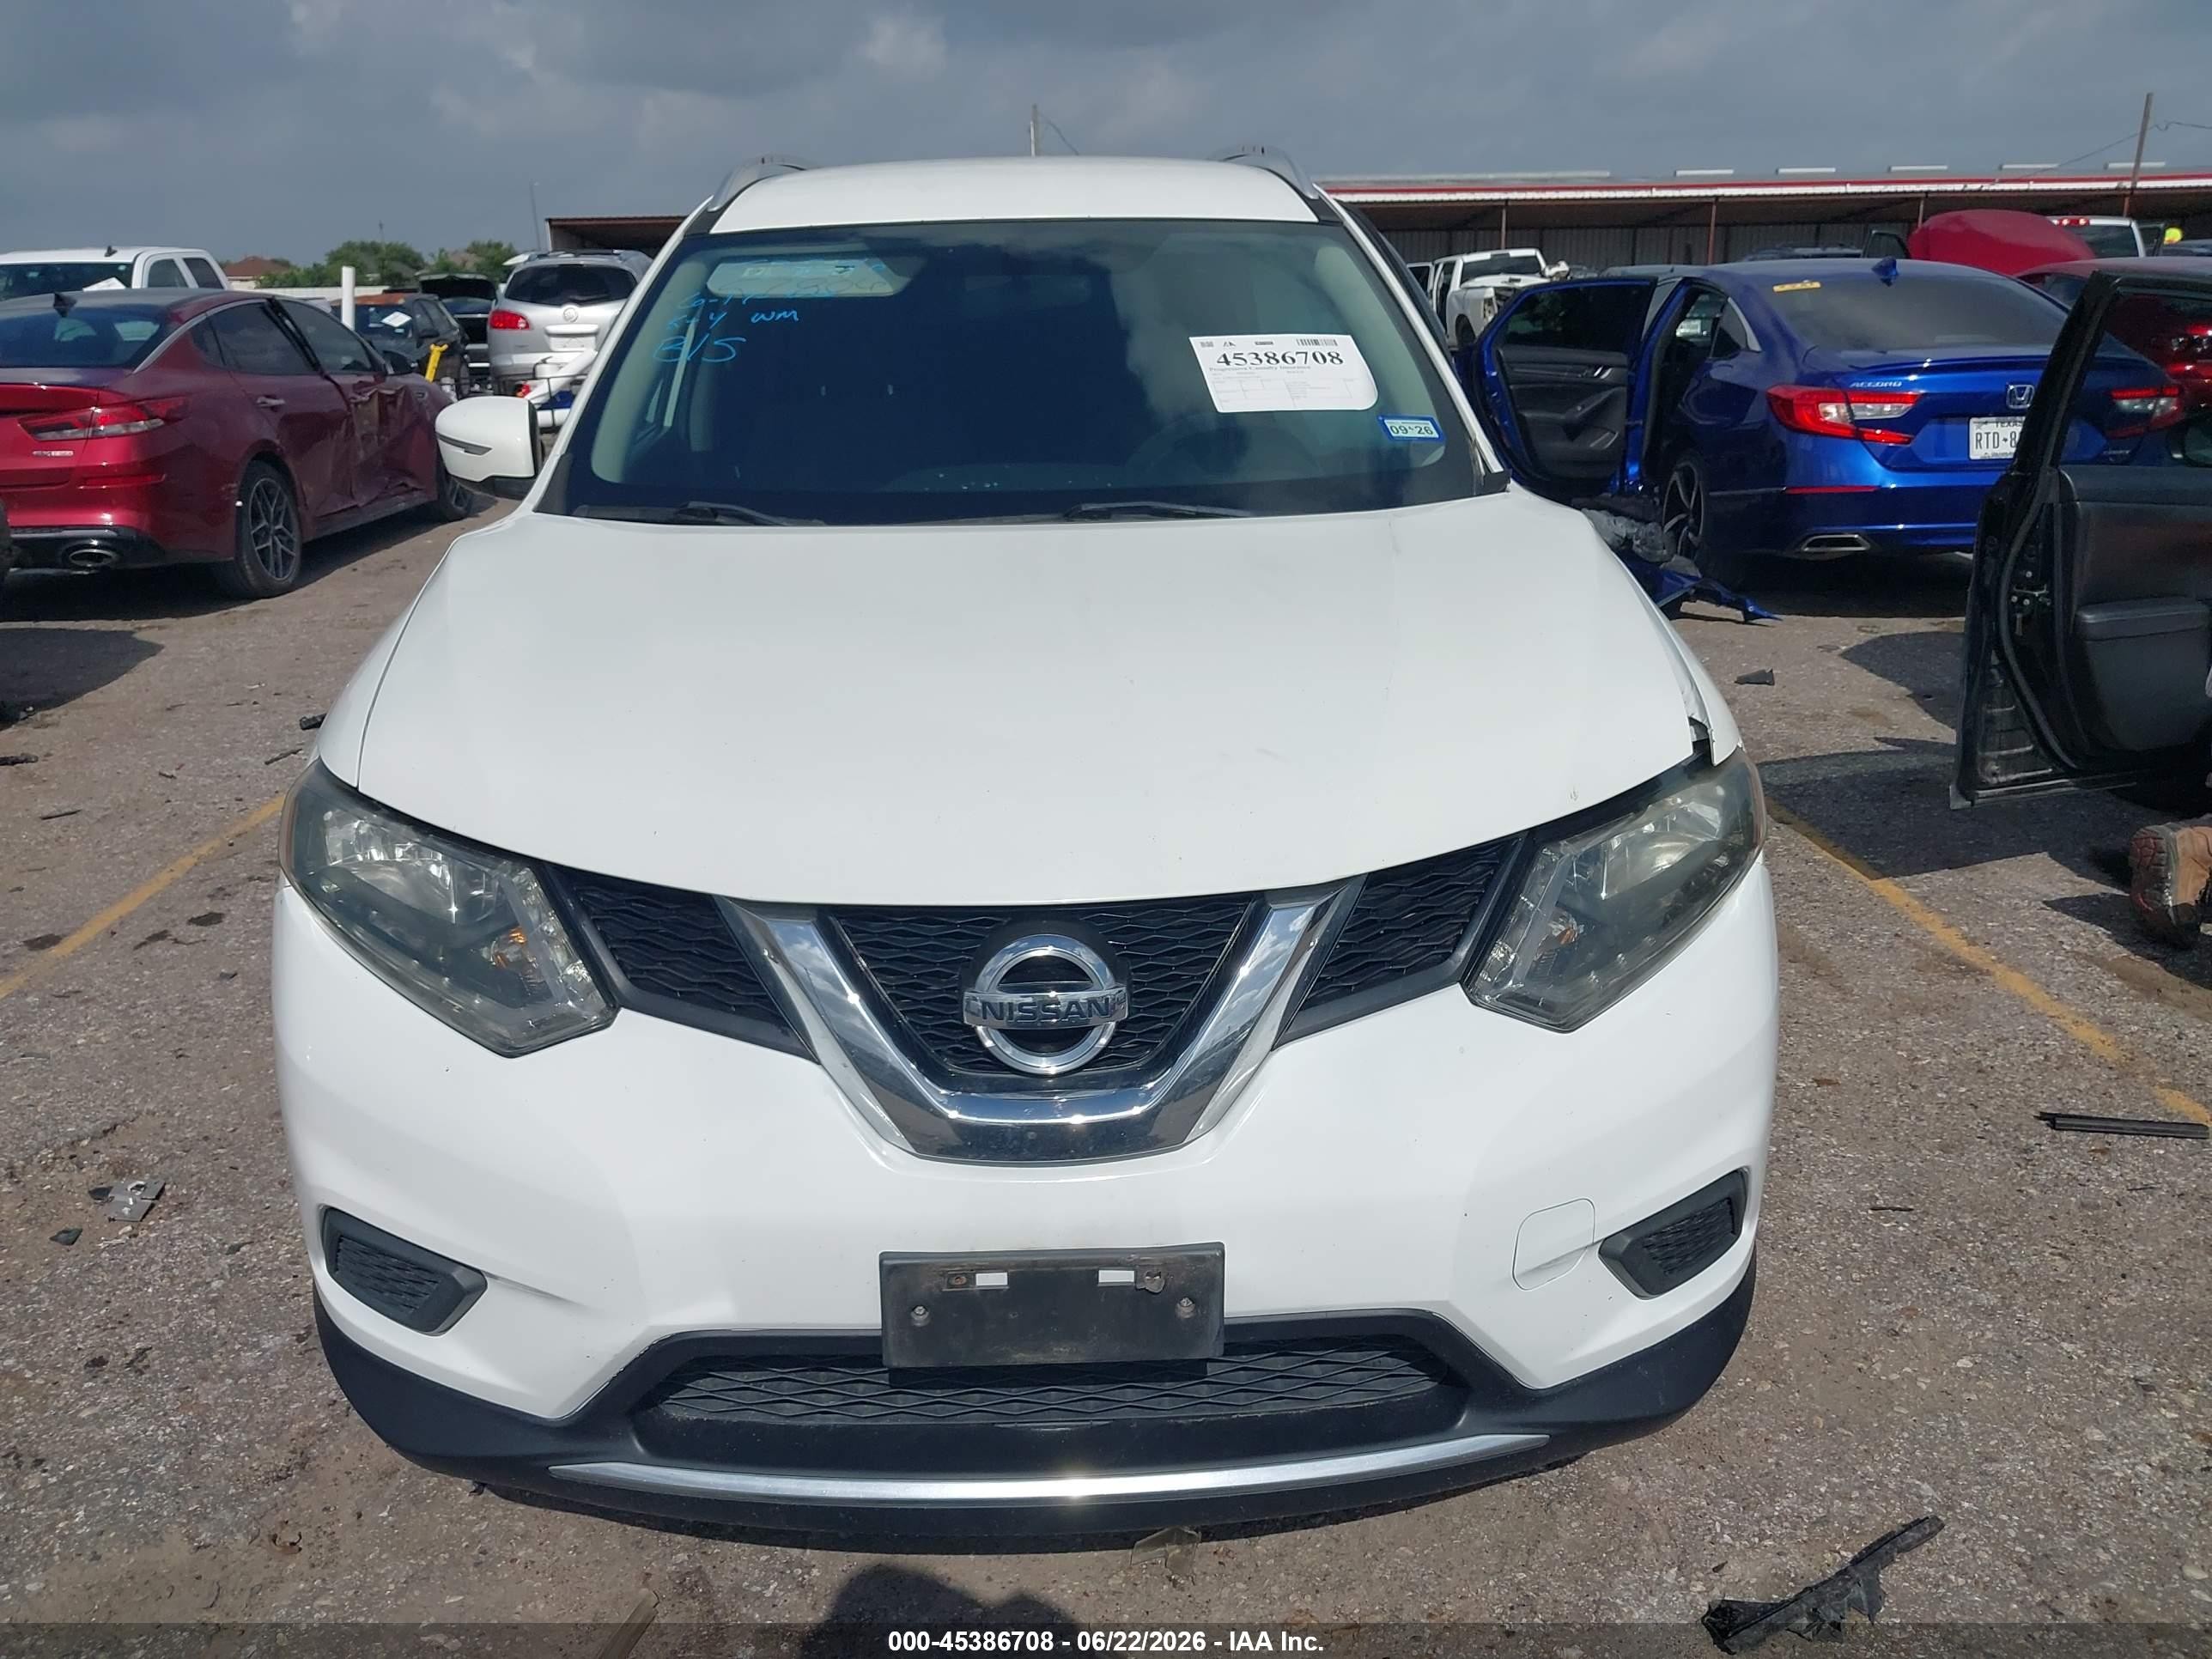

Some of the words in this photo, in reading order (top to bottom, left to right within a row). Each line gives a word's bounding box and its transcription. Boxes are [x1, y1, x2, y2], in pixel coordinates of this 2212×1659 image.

[1217, 350, 1344, 367] 45386708
[1389, 425, 1409, 434] 09
[1414, 425, 1434, 435] 26
[981, 998, 1112, 1021] NISSAN
